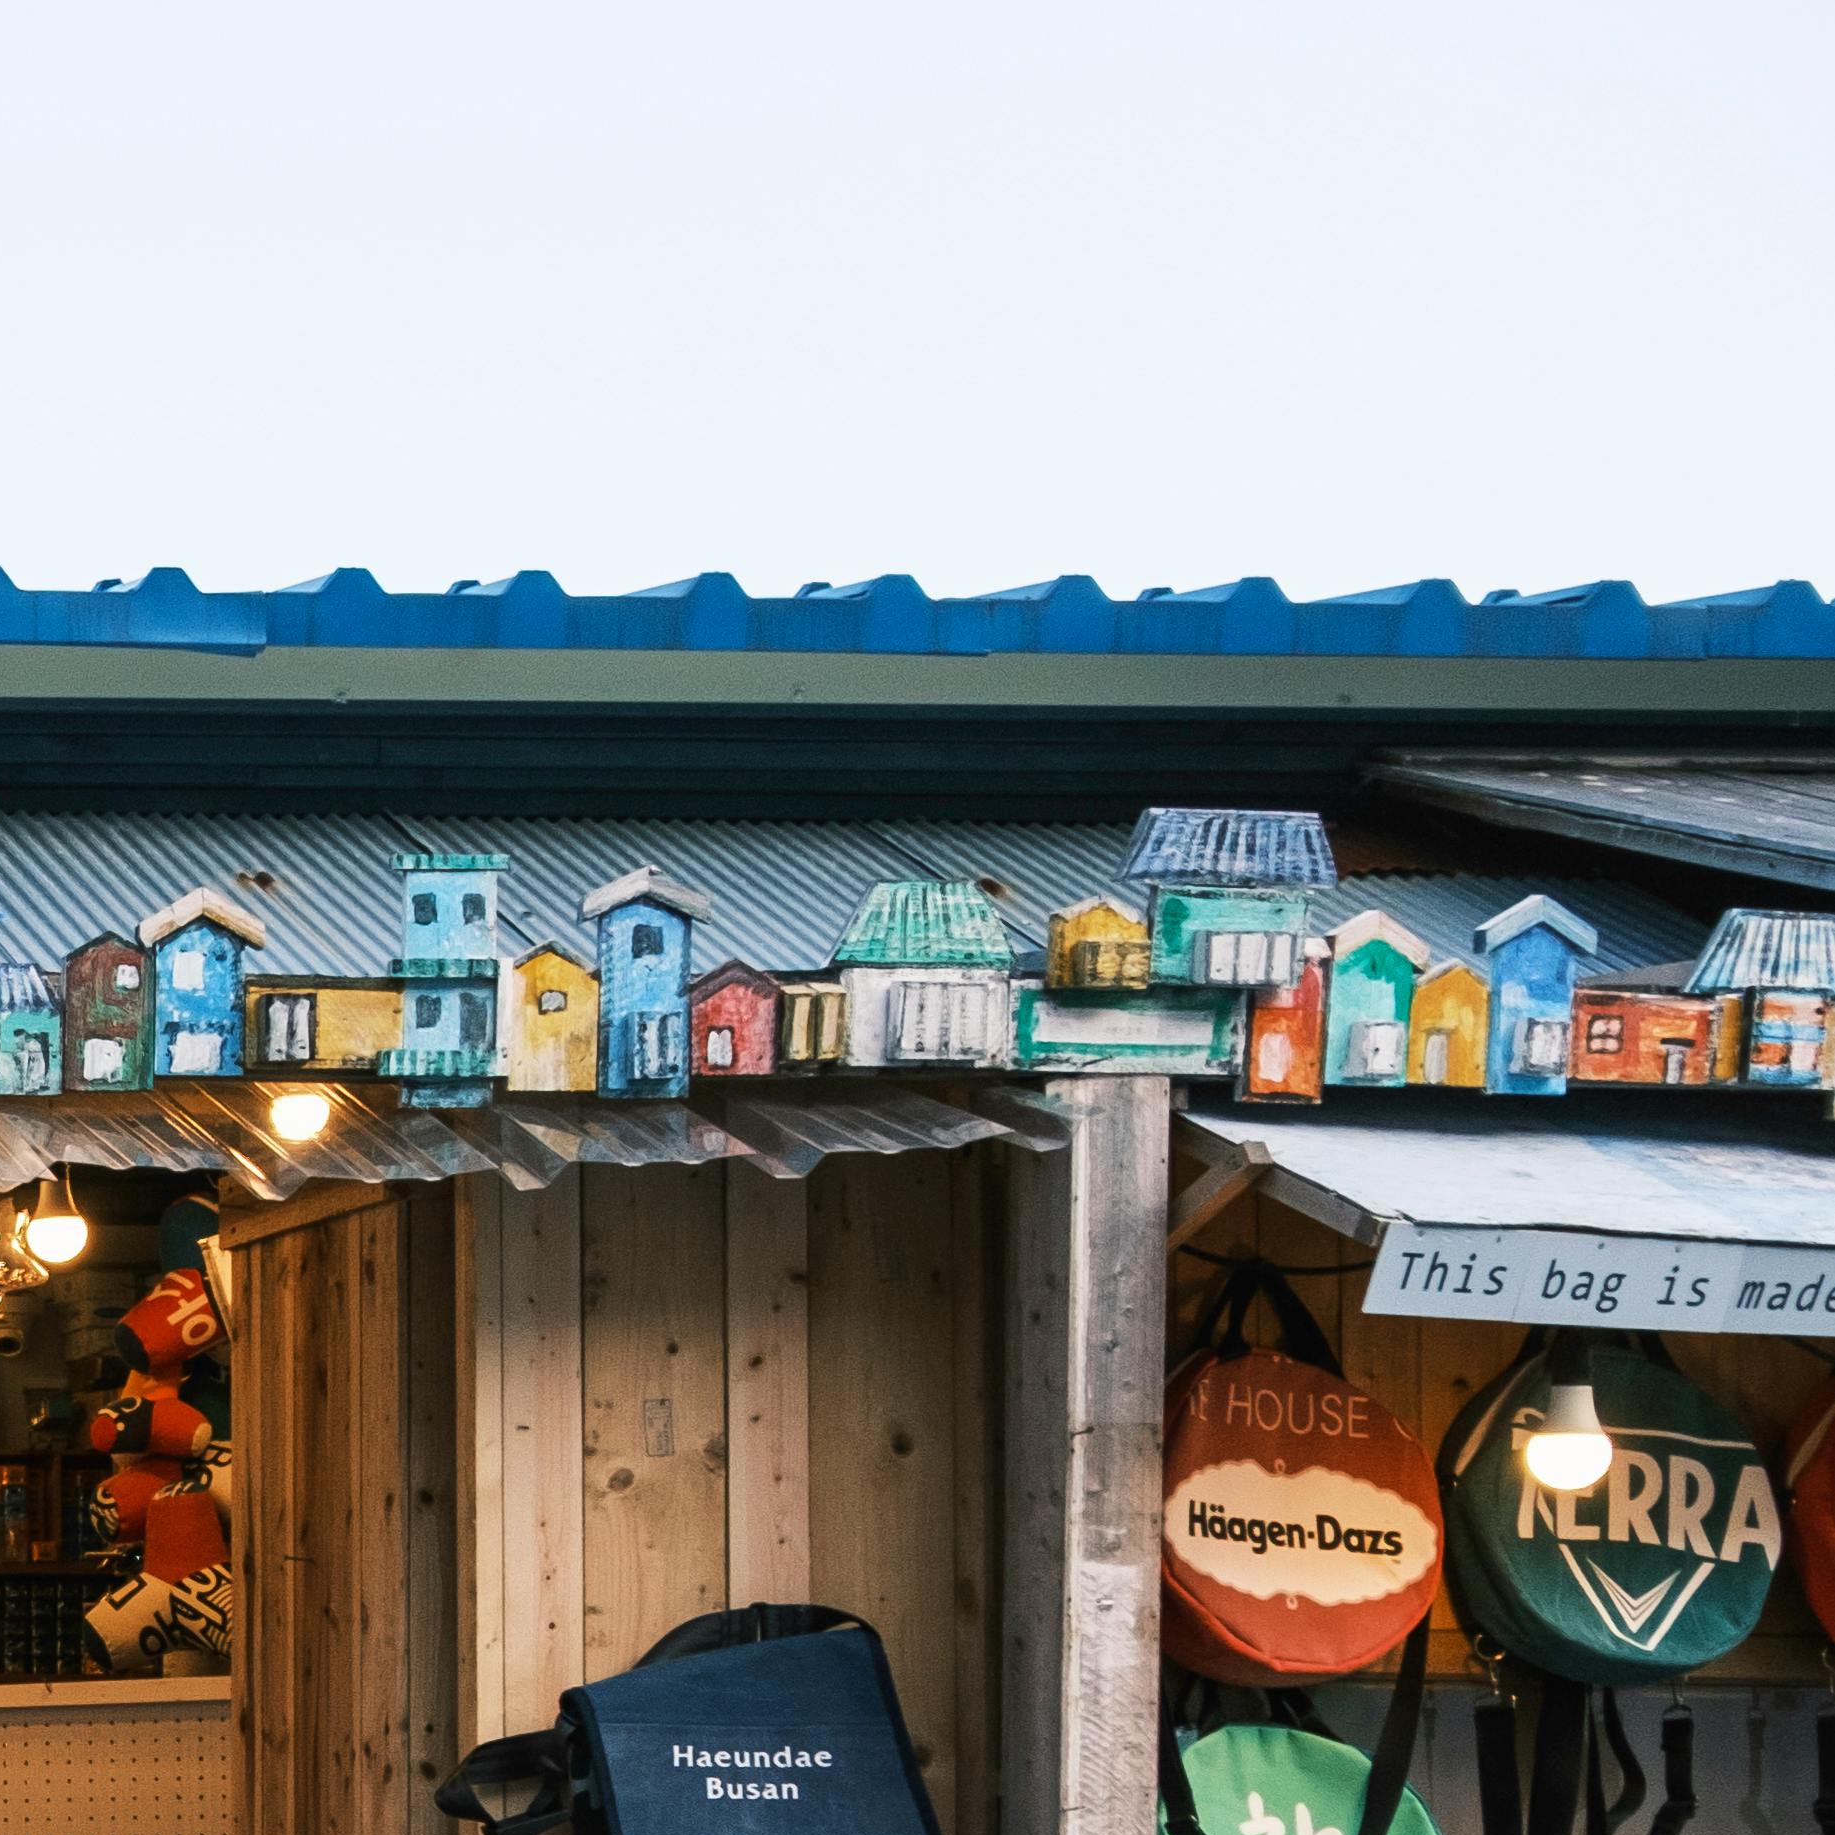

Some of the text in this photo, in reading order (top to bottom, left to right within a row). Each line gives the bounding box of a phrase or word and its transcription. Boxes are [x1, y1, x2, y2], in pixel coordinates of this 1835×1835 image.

[1398, 1252, 1506, 1295] This
[1541, 1259, 1627, 1313] bag
[1656, 1262, 1710, 1307] is
[1226, 1383, 1370, 1439] HOUSE
[672, 1744, 834, 1769] Haeundae
[705, 1775, 800, 1802] Busan
